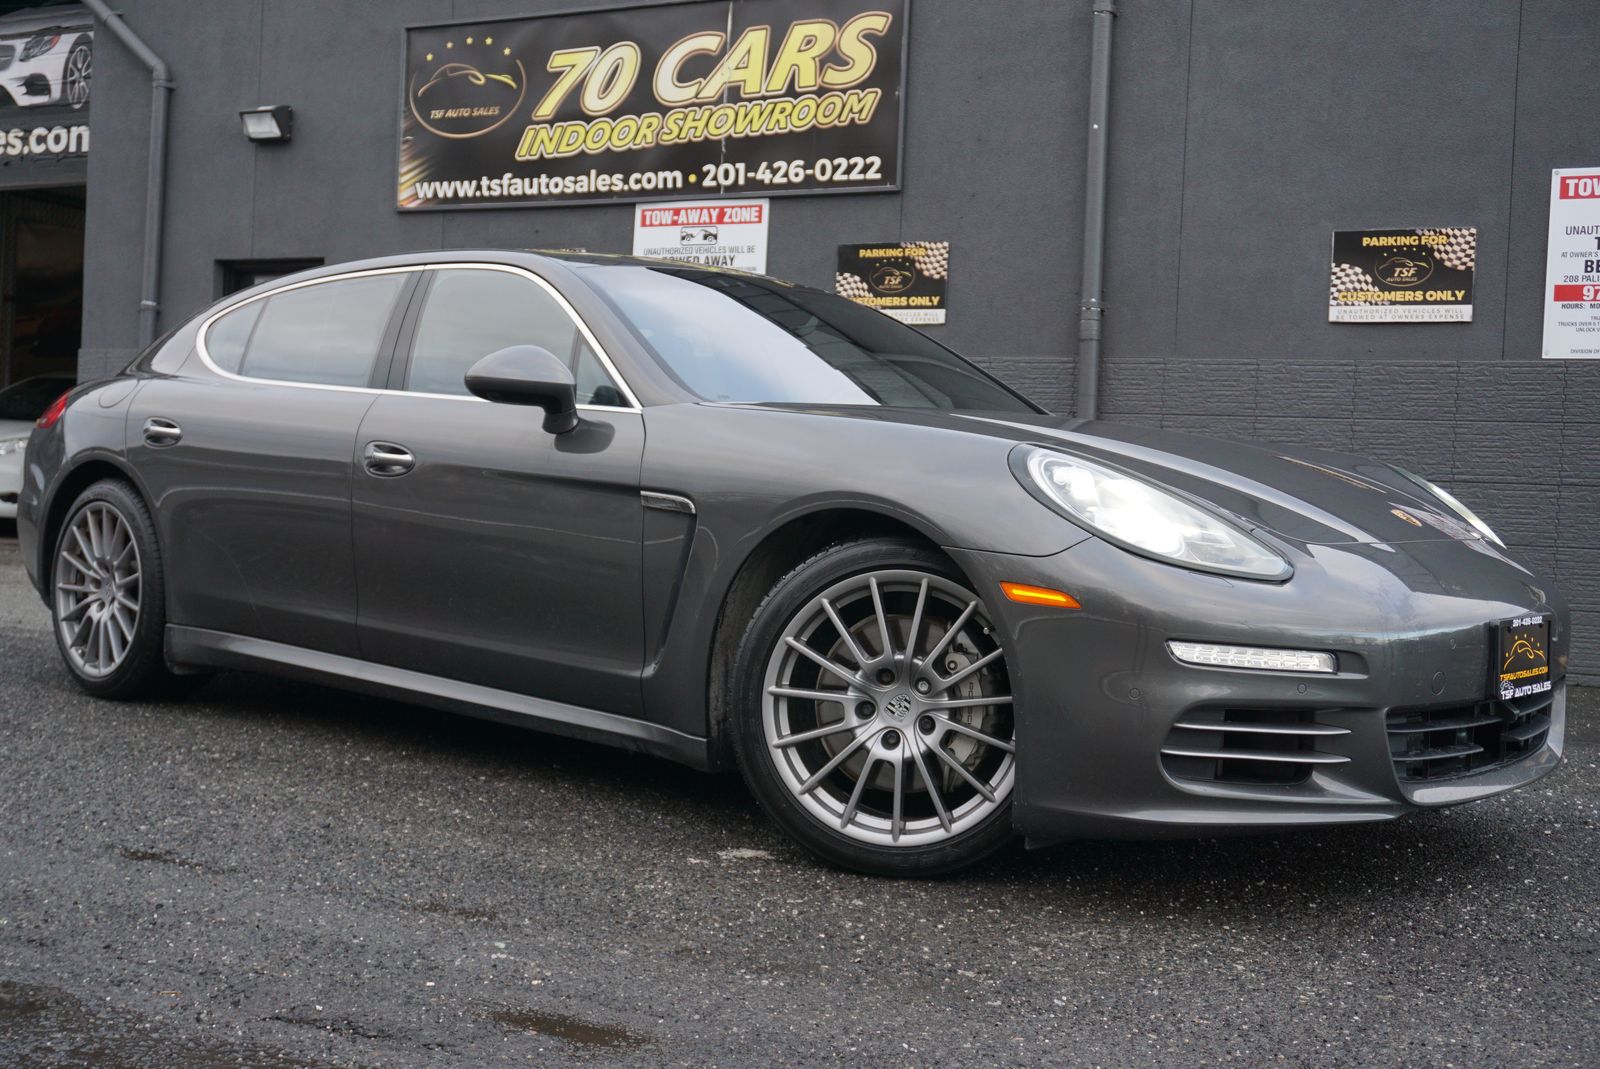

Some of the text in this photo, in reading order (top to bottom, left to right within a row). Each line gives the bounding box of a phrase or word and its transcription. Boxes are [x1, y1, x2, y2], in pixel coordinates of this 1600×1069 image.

[532, 11, 892, 121] 70 CARS
[430, 106, 500, 119] TSF AUTO SALES
[515, 88, 881, 161] INDOOR SHOWROOM
[415, 156, 882, 199] www.tsfautosales.com 201-426-0222
[644, 206, 760, 225] TOW-AWAY ZONE
[1362, 235, 1447, 247] PARKING FOR
[643, 245, 756, 256] UNAUTHORIZED VEHICLES WILL BE
[859, 247, 926, 258] PARKING FOR
[704, 255, 736, 267] AWAY
[1393, 267, 1417, 277] TSF
[884, 276, 903, 285] TSF
[1563, 275, 1579, 283] 208
[908, 296, 940, 306] ONLY
[1338, 290, 1465, 302] CUSTOMERS ONLY
[1501, 681, 1552, 700] TSF AUTO SALES
